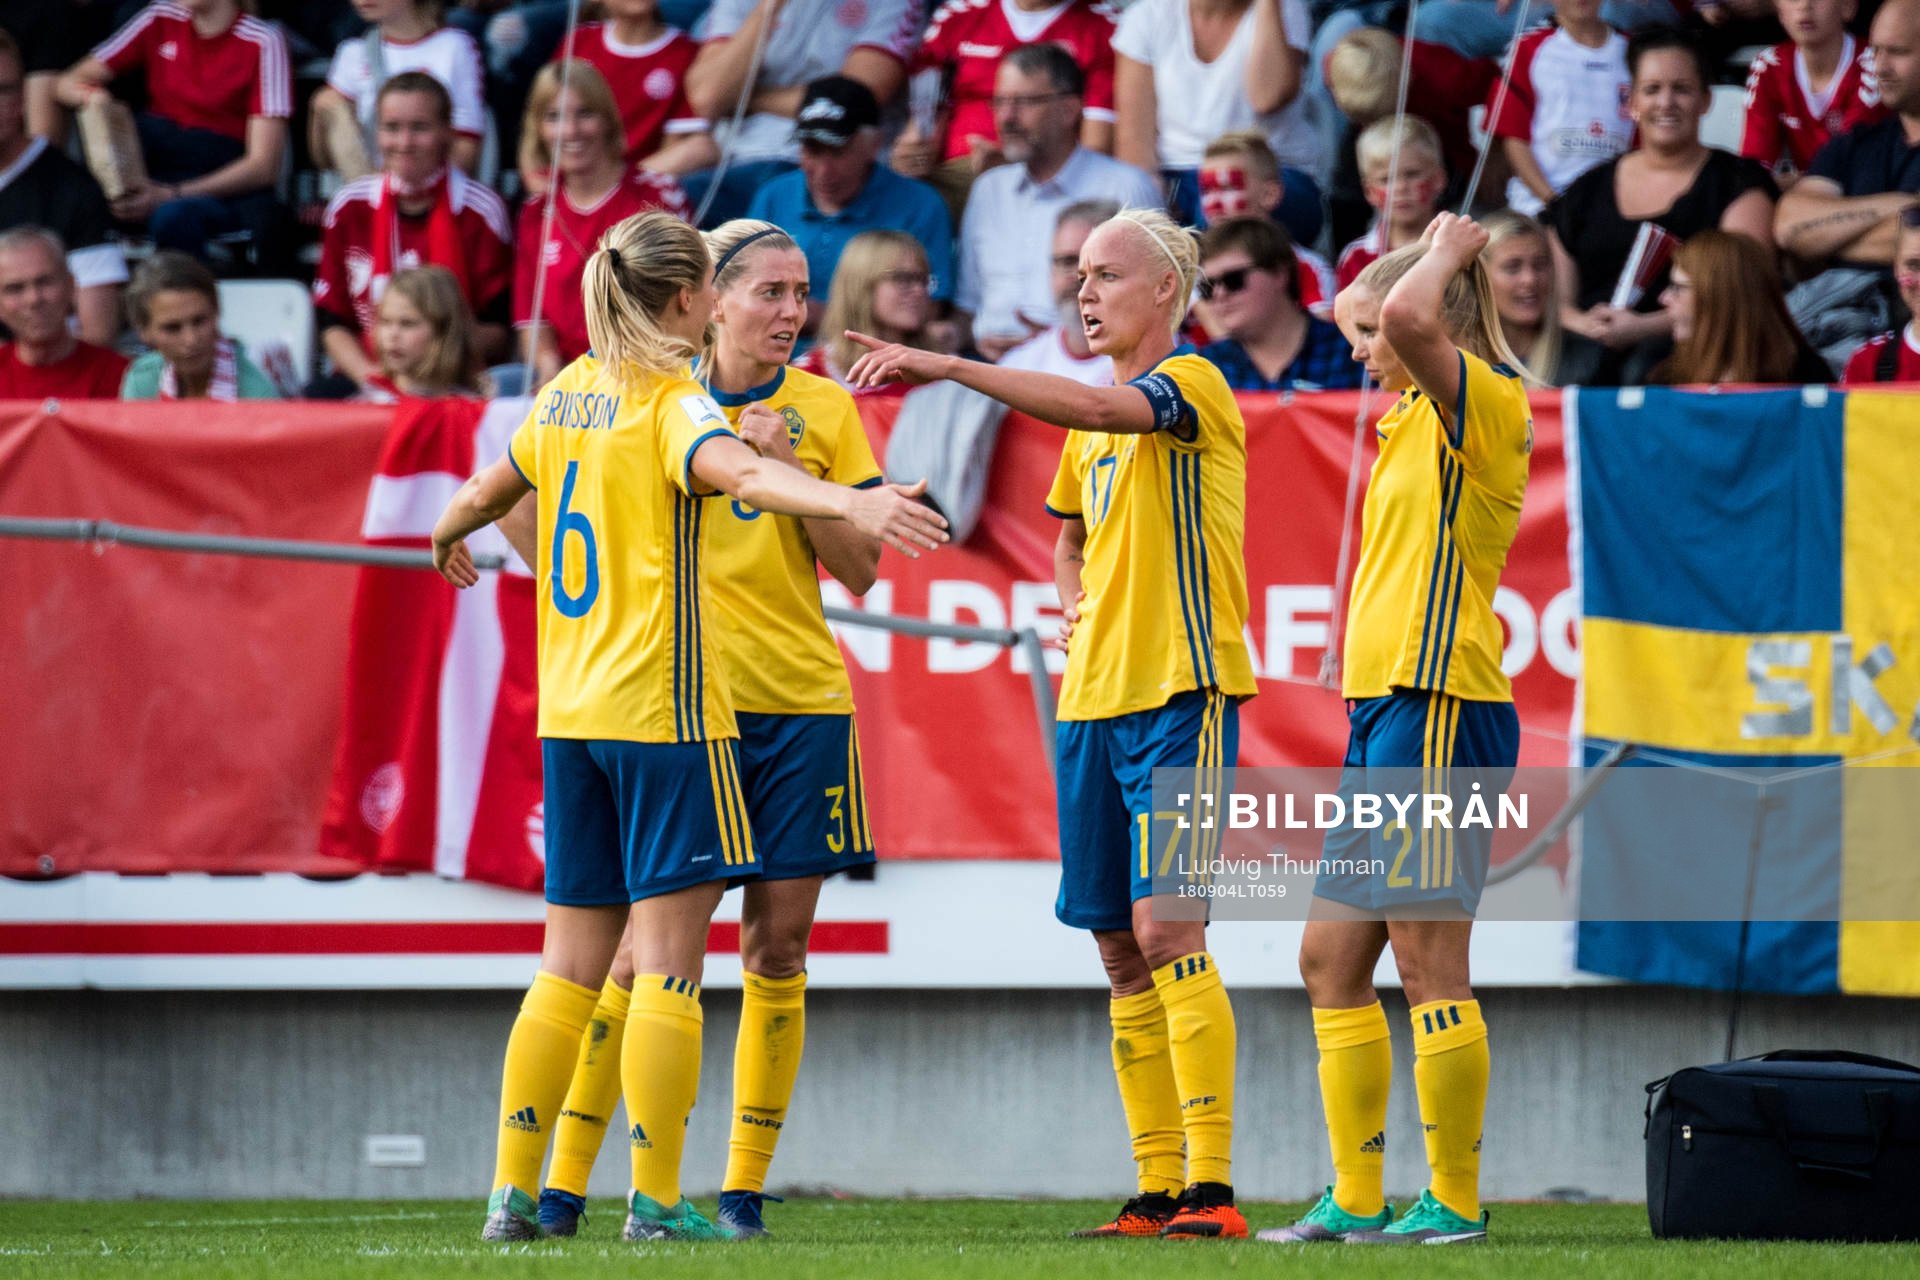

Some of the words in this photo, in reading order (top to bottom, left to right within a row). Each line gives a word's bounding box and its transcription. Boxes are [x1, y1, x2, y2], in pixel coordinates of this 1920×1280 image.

[1090, 454, 1118, 527] 17
[552, 460, 600, 619] 6
[1740, 634, 1920, 742] SK
[825, 785, 845, 853] 3
[1137, 812, 1187, 878] 17
[1383, 819, 1413, 888] 2
[505, 1119, 541, 1133] adidas
